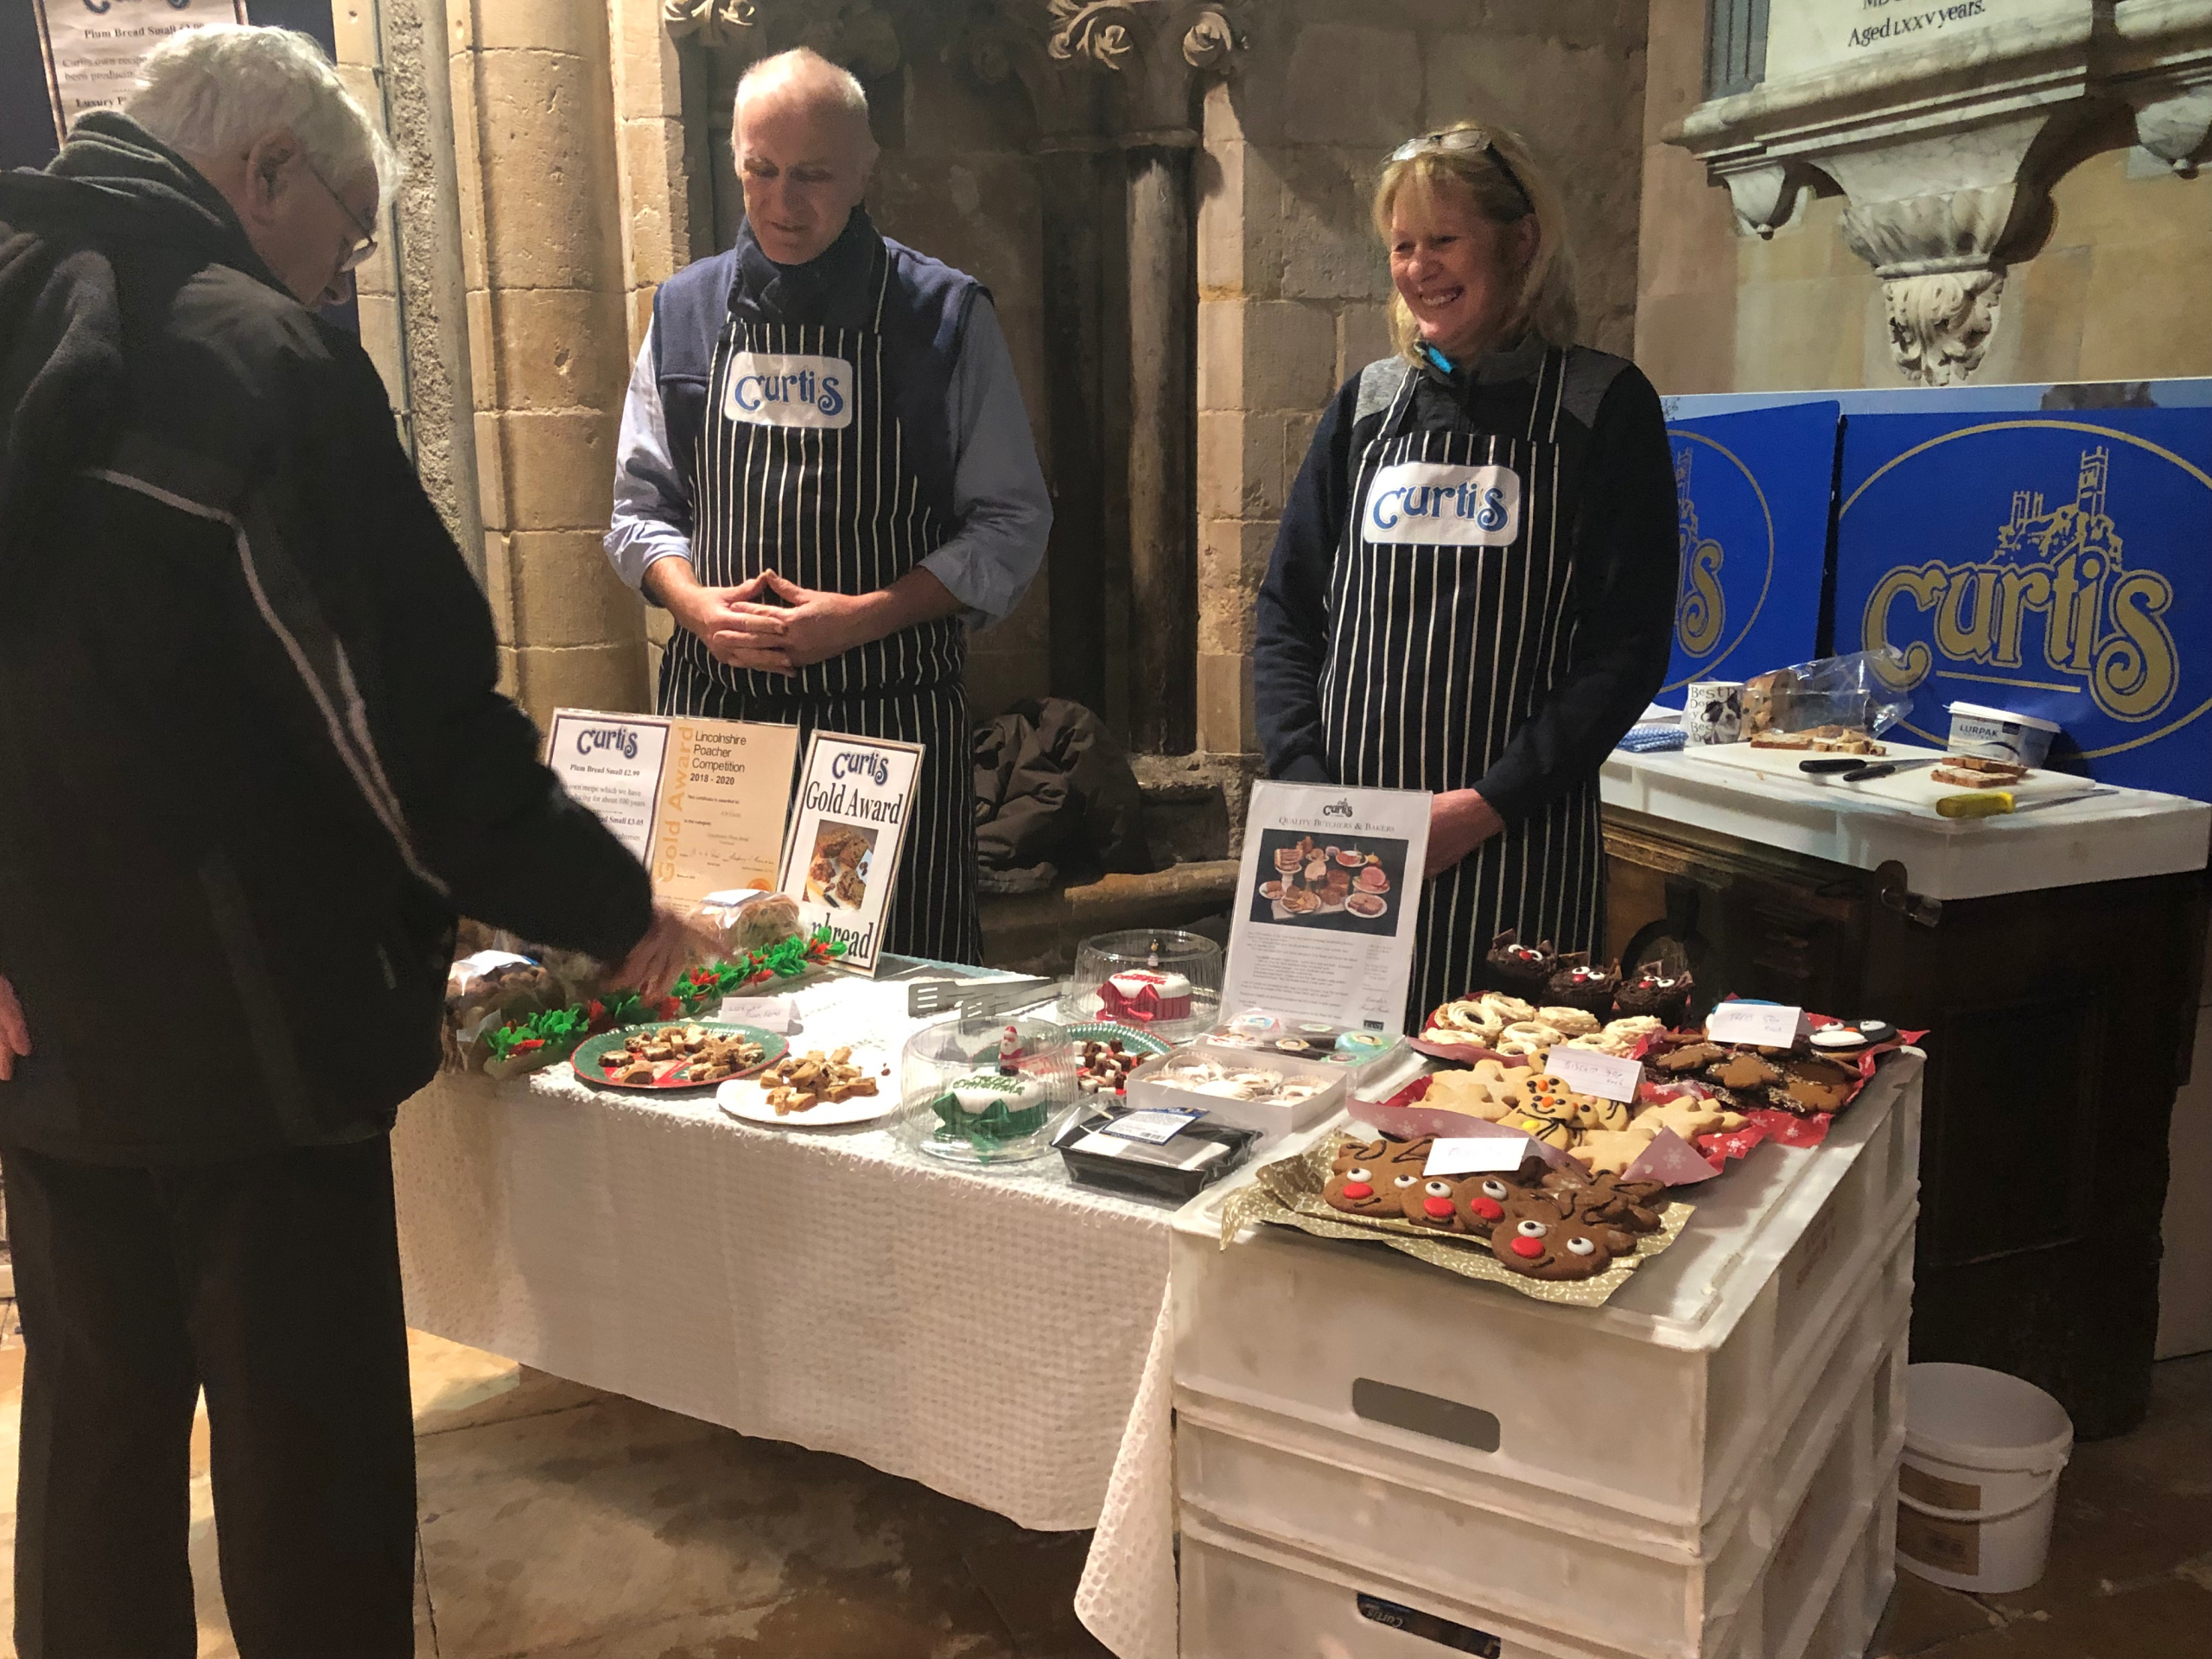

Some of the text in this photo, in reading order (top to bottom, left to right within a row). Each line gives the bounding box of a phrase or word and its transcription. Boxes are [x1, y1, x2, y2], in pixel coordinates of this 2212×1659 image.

[1847, 17, 1891, 47] Aged
[1937, 0, 1986, 29] years.
[85, 29, 111, 39] Plum
[114, 28, 145, 38] Bread
[148, 25, 176, 35] Small
[75, 98, 114, 109] Luxury
[734, 369, 844, 416] Curtis
[1372, 482, 1509, 532] Curtis
[1862, 547, 2180, 722] Curtis
[695, 730, 747, 746] Lincolnshire
[1960, 724, 1999, 737] LURPAK
[576, 728, 639, 759] Curtis
[693, 744, 732, 758] Poacher
[569, 764, 586, 772] Plum
[587, 766, 605, 774] Bread
[668, 726, 694, 811] Award
[691, 758, 746, 773] Competition
[831, 751, 889, 786] Curtis
[690, 772, 709, 783] 2018
[716, 775, 734, 785] 2020
[600, 785, 617, 794] which
[601, 795, 618, 804] about
[805, 780, 904, 824] Gold Award
[1354, 822, 1363, 830] &
[658, 820, 681, 882] Gold
